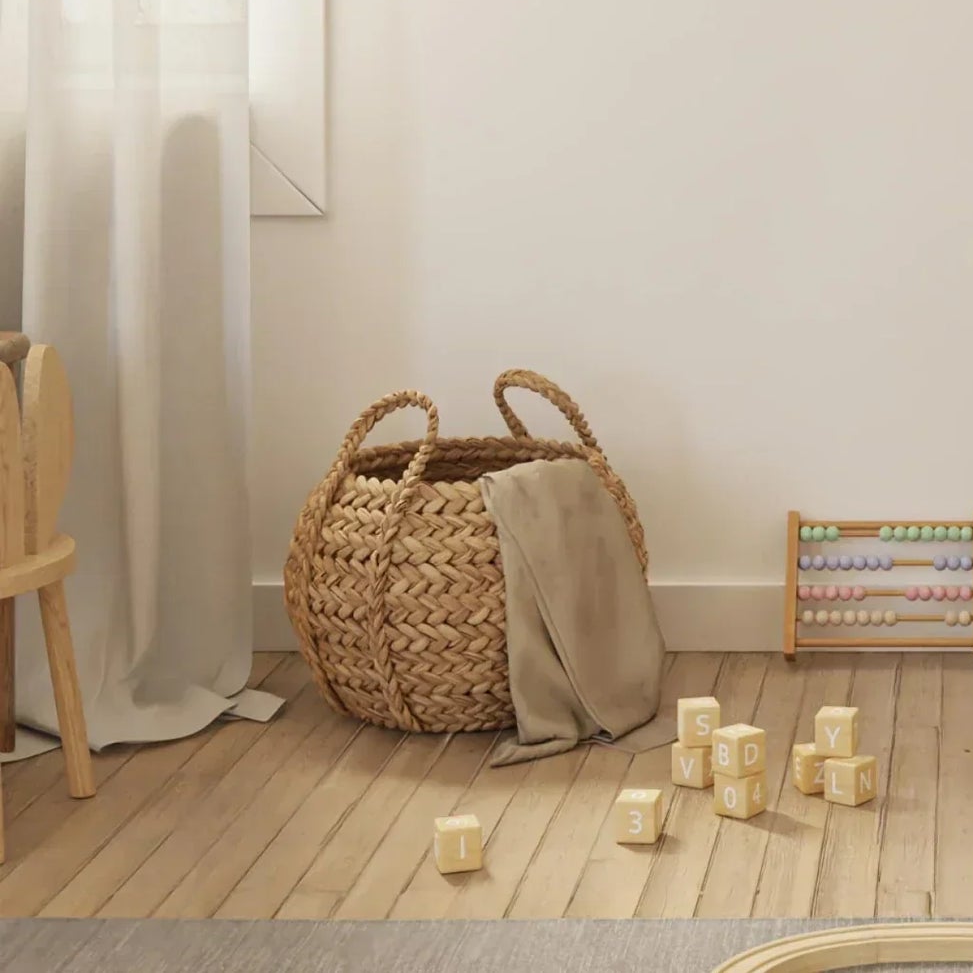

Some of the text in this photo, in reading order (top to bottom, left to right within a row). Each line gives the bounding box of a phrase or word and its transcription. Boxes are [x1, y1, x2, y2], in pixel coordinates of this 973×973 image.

[696, 714, 710, 736] S
[824, 726, 840, 748] Y
[718, 743, 730, 766] B
[745, 743, 758, 766] D
[680, 757, 695, 779] V
[831, 772, 843, 794] L
[860, 769, 872, 793] N
[629, 810, 643, 835] 3
